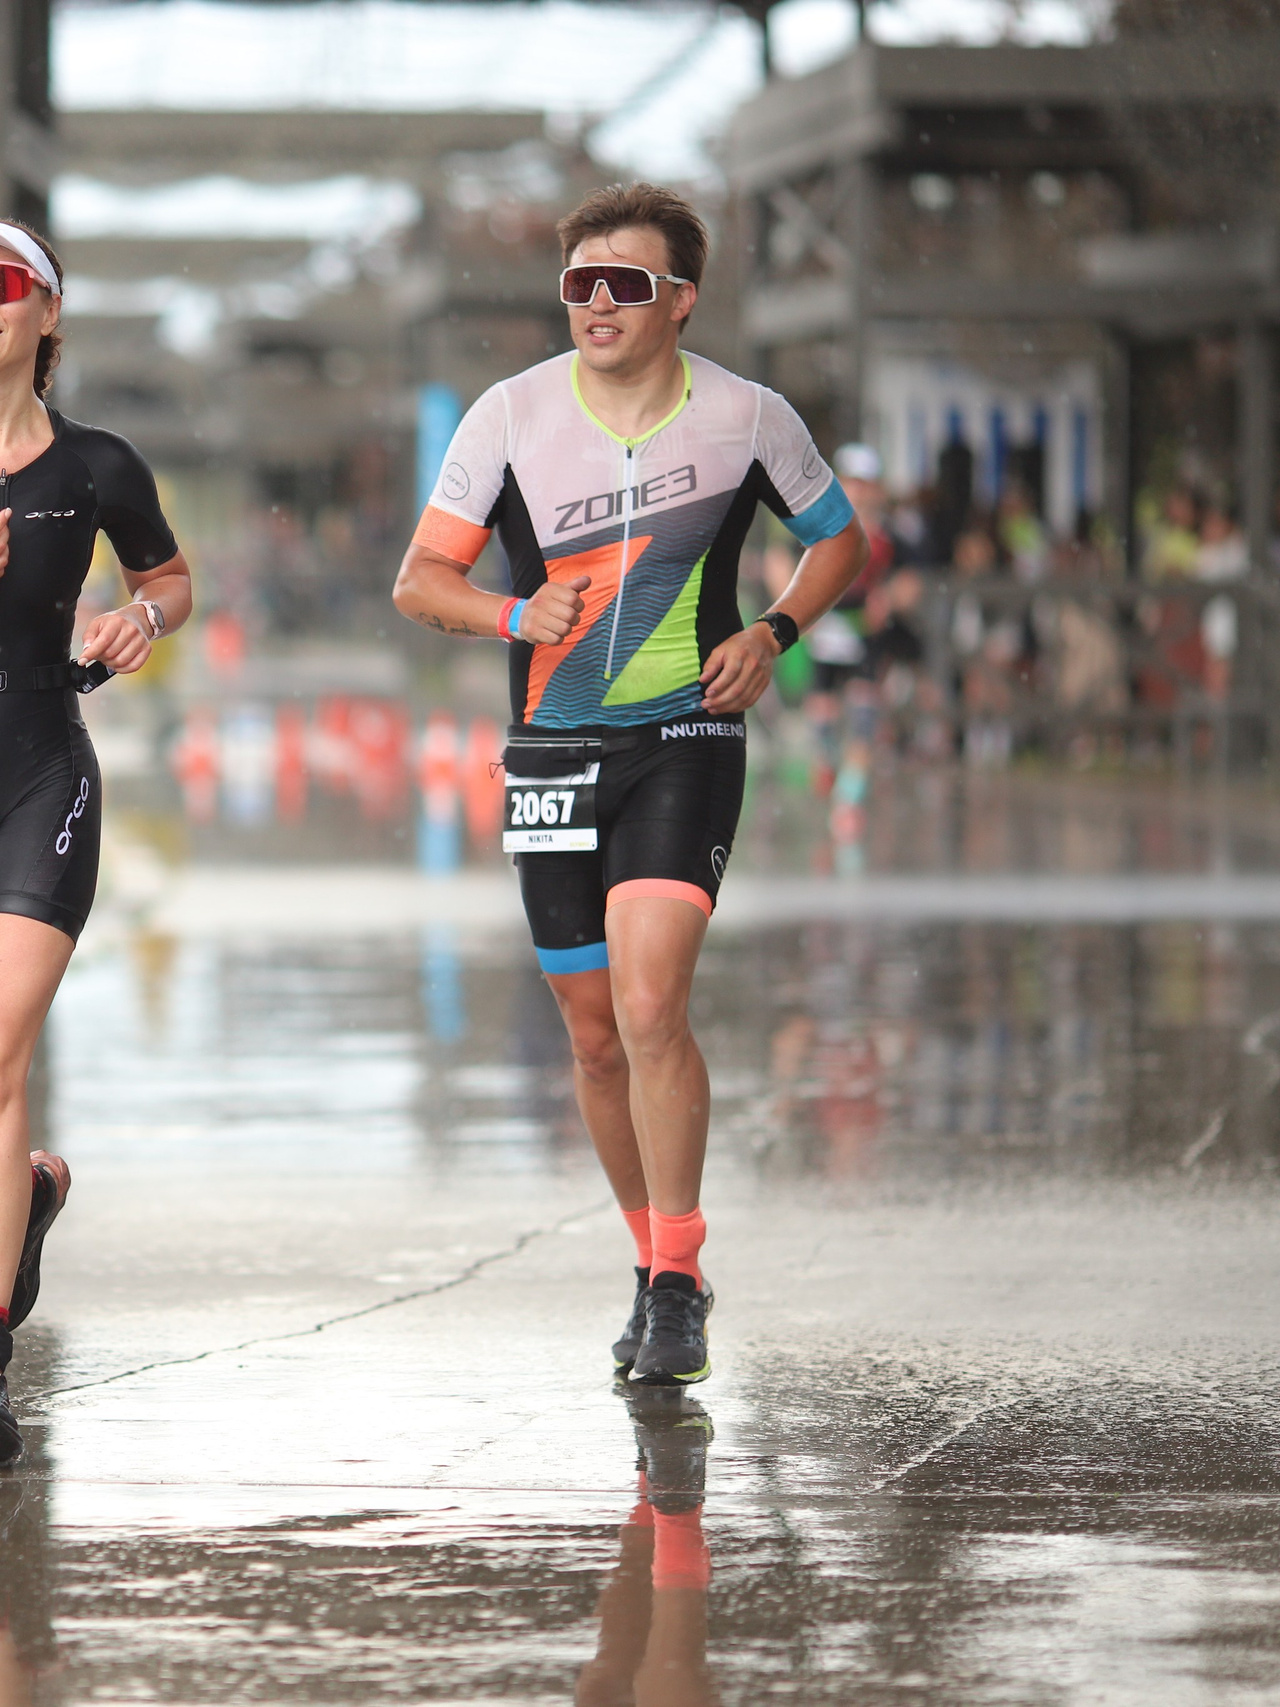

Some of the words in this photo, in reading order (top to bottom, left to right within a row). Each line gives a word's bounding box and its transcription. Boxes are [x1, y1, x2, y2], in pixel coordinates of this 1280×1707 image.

[55, 776, 90, 856] orca
[510, 790, 576, 826] 2067
[528, 834, 554, 844] NIKITA
